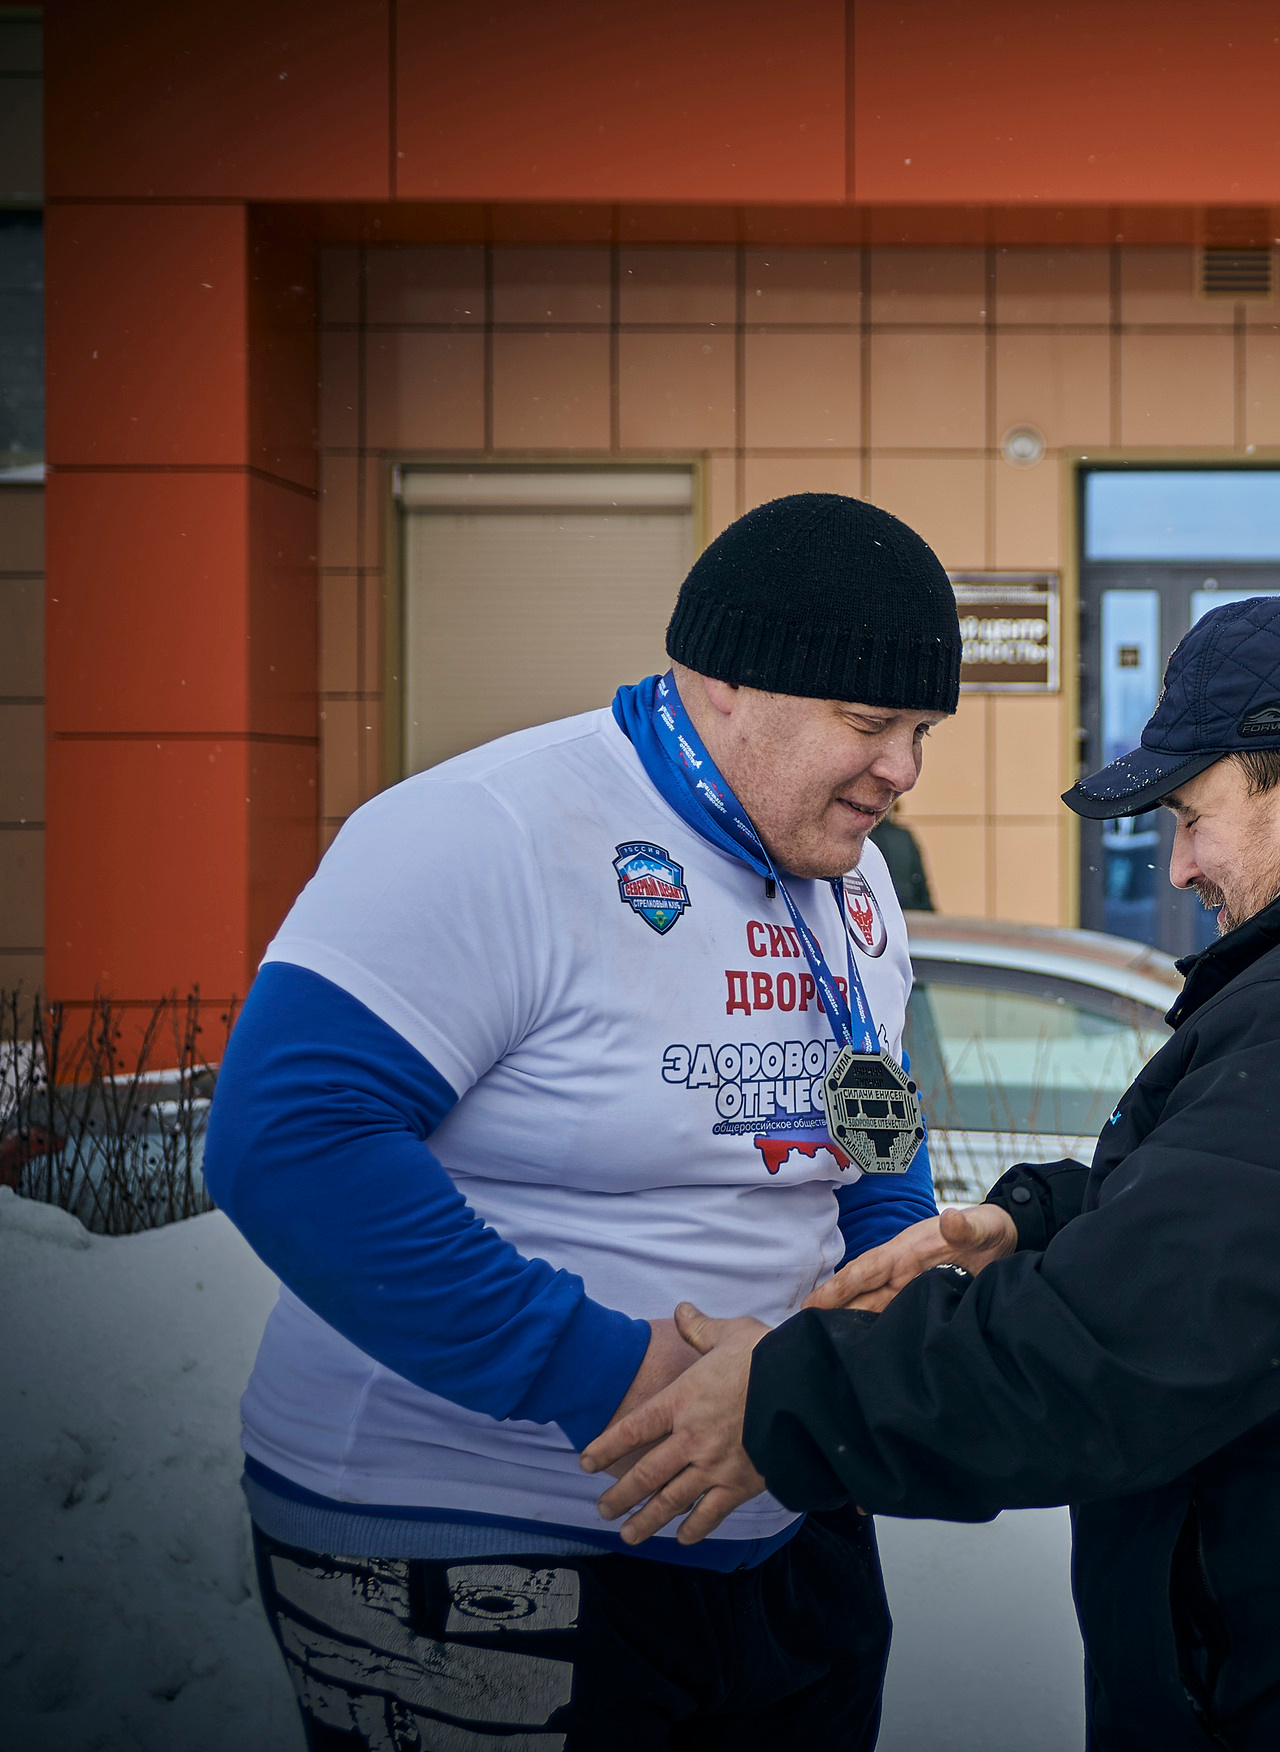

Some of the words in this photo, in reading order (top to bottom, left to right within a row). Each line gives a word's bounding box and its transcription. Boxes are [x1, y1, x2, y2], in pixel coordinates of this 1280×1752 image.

[746, 920, 824, 958] СИЛ
[833, 1053, 852, 1081] СИЛА
[883, 1055, 908, 1085] ДВОРОВ
[843, 1089, 874, 1099] СИЛАЧИ
[875, 1090, 904, 1101] ЕНИСЕЯ
[714, 1120, 791, 1134] общероссийское
[848, 1118, 878, 1128] ЗДОРОВОЕ
[878, 1119, 909, 1129] ОТЕЧЕСТВО
[842, 1136, 872, 1170] СИЛОВОЙ
[876, 1162, 896, 1172] 2023
[900, 1136, 921, 1171] ЭКСТРИМ
